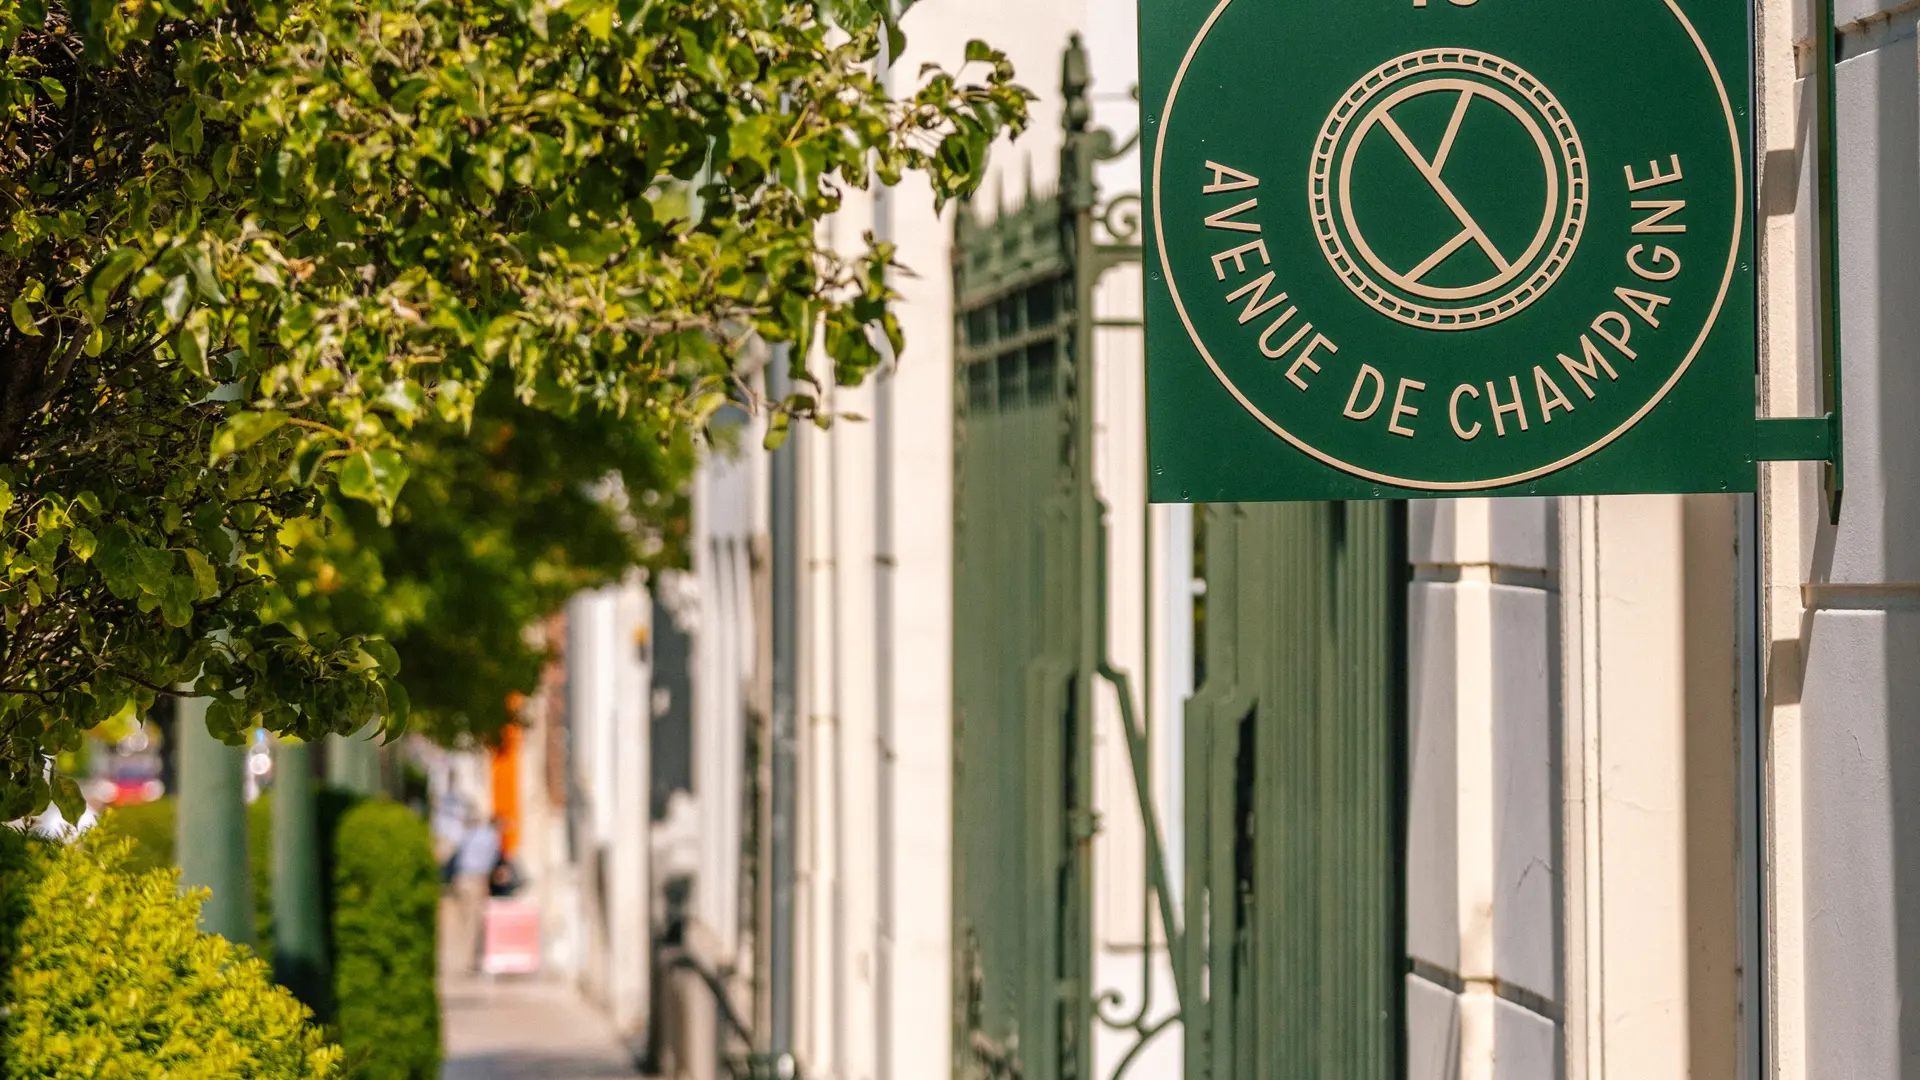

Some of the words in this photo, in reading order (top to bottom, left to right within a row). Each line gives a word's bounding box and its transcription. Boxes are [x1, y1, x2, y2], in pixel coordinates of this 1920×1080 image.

[1202, 159, 1338, 391] AVENUE
[1342, 363, 1426, 437] DE
[1449, 153, 1687, 440] CHAMPAGNE
